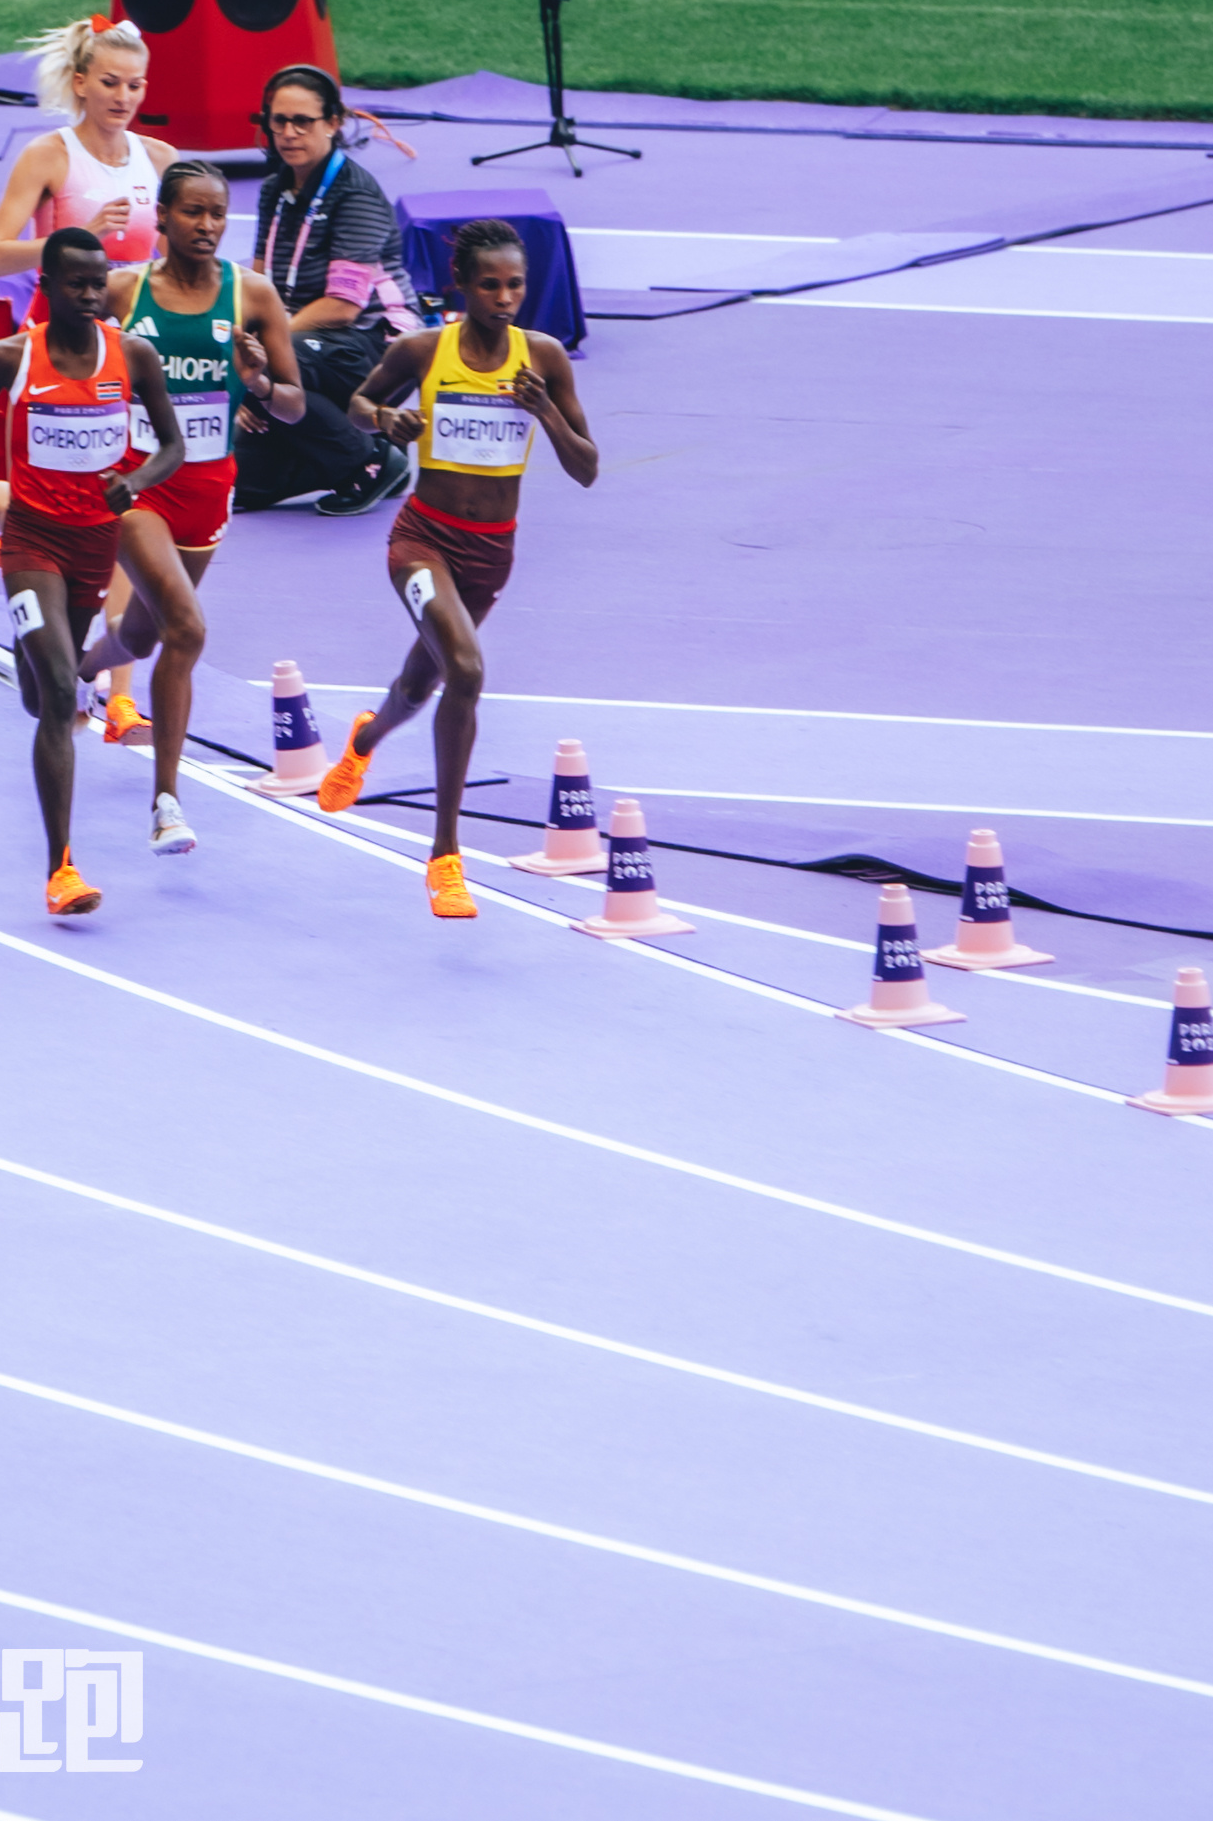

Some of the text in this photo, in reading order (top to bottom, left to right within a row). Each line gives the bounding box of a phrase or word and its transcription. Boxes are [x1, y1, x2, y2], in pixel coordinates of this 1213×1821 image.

[32, 424, 126, 450] CHEROTICH
[136, 415, 221, 439] META
[12, 602, 29, 626] 11
